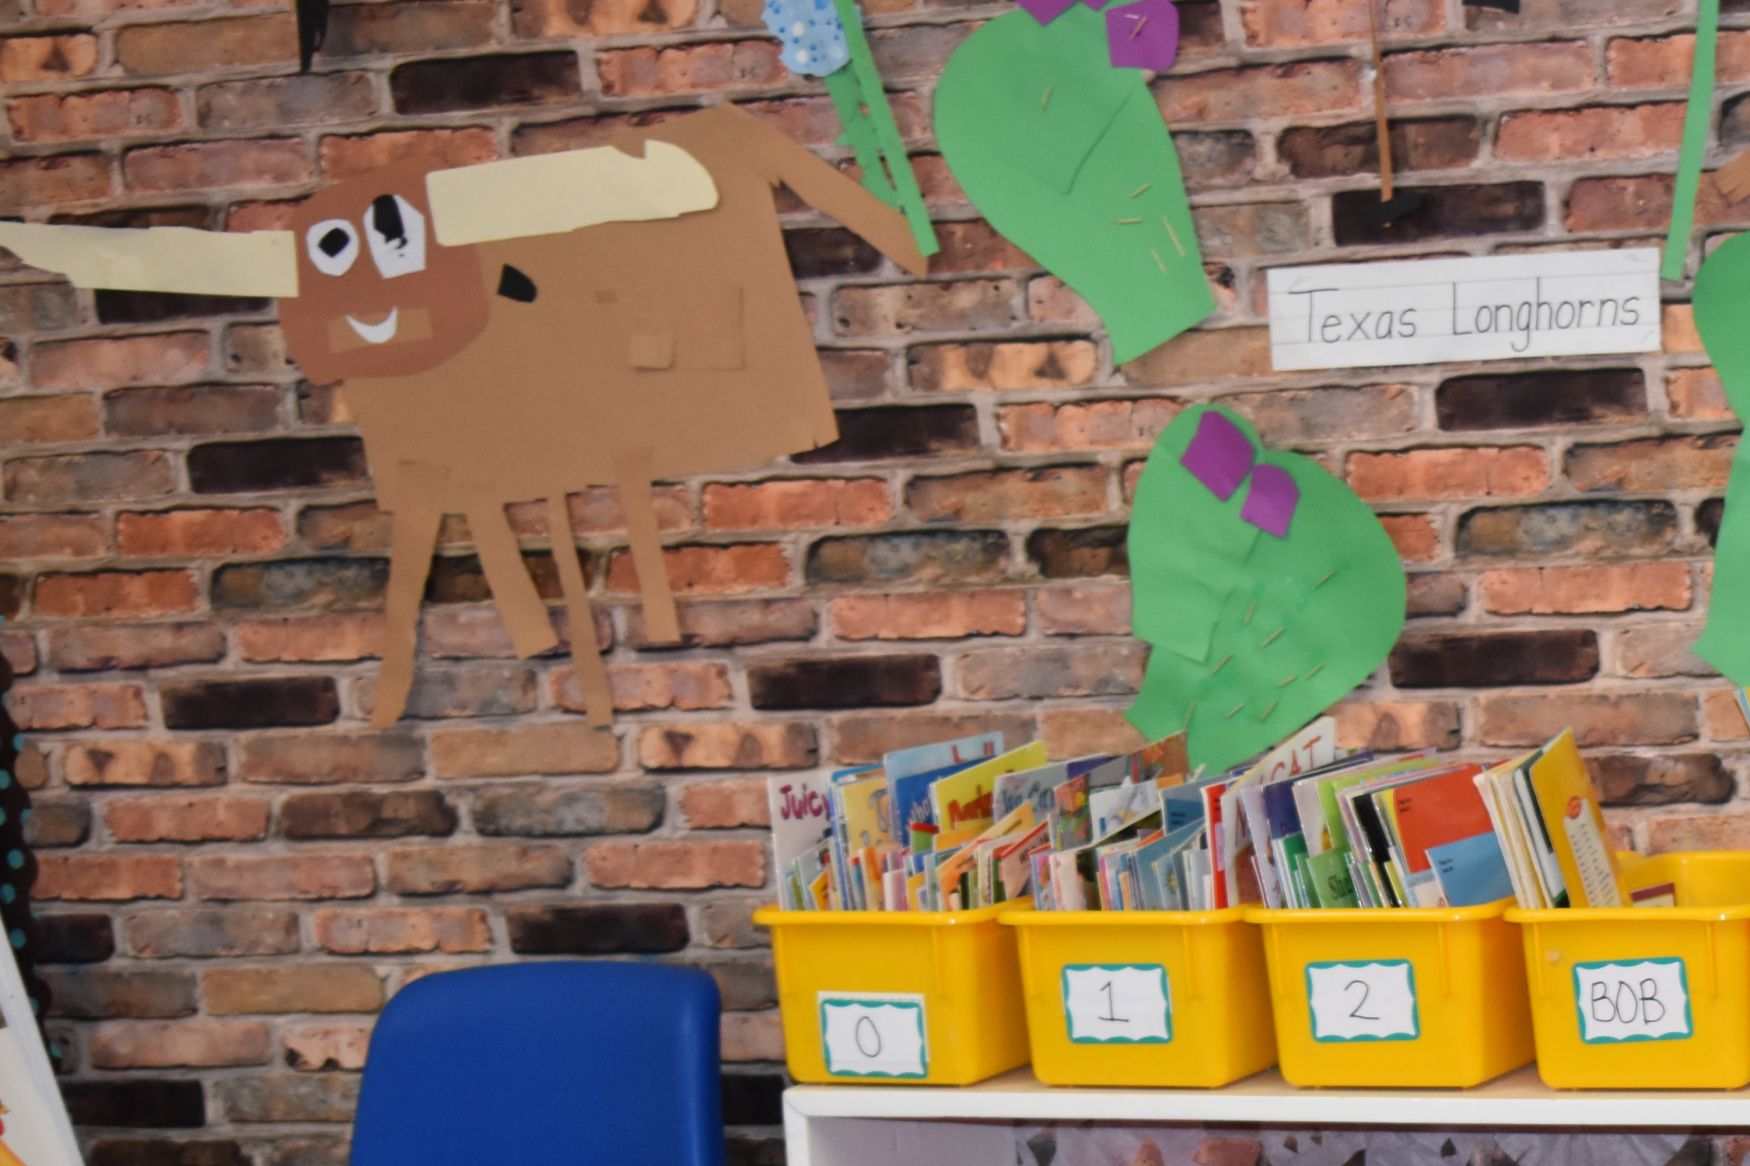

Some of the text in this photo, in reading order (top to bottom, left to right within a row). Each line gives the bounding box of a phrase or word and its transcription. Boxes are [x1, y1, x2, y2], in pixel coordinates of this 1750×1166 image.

[1288, 276, 1641, 353] Texas Longhorns
[1097, 980, 1130, 1023] 1
[1343, 979, 1381, 1021] 2
[1590, 977, 1667, 1025] BOB
